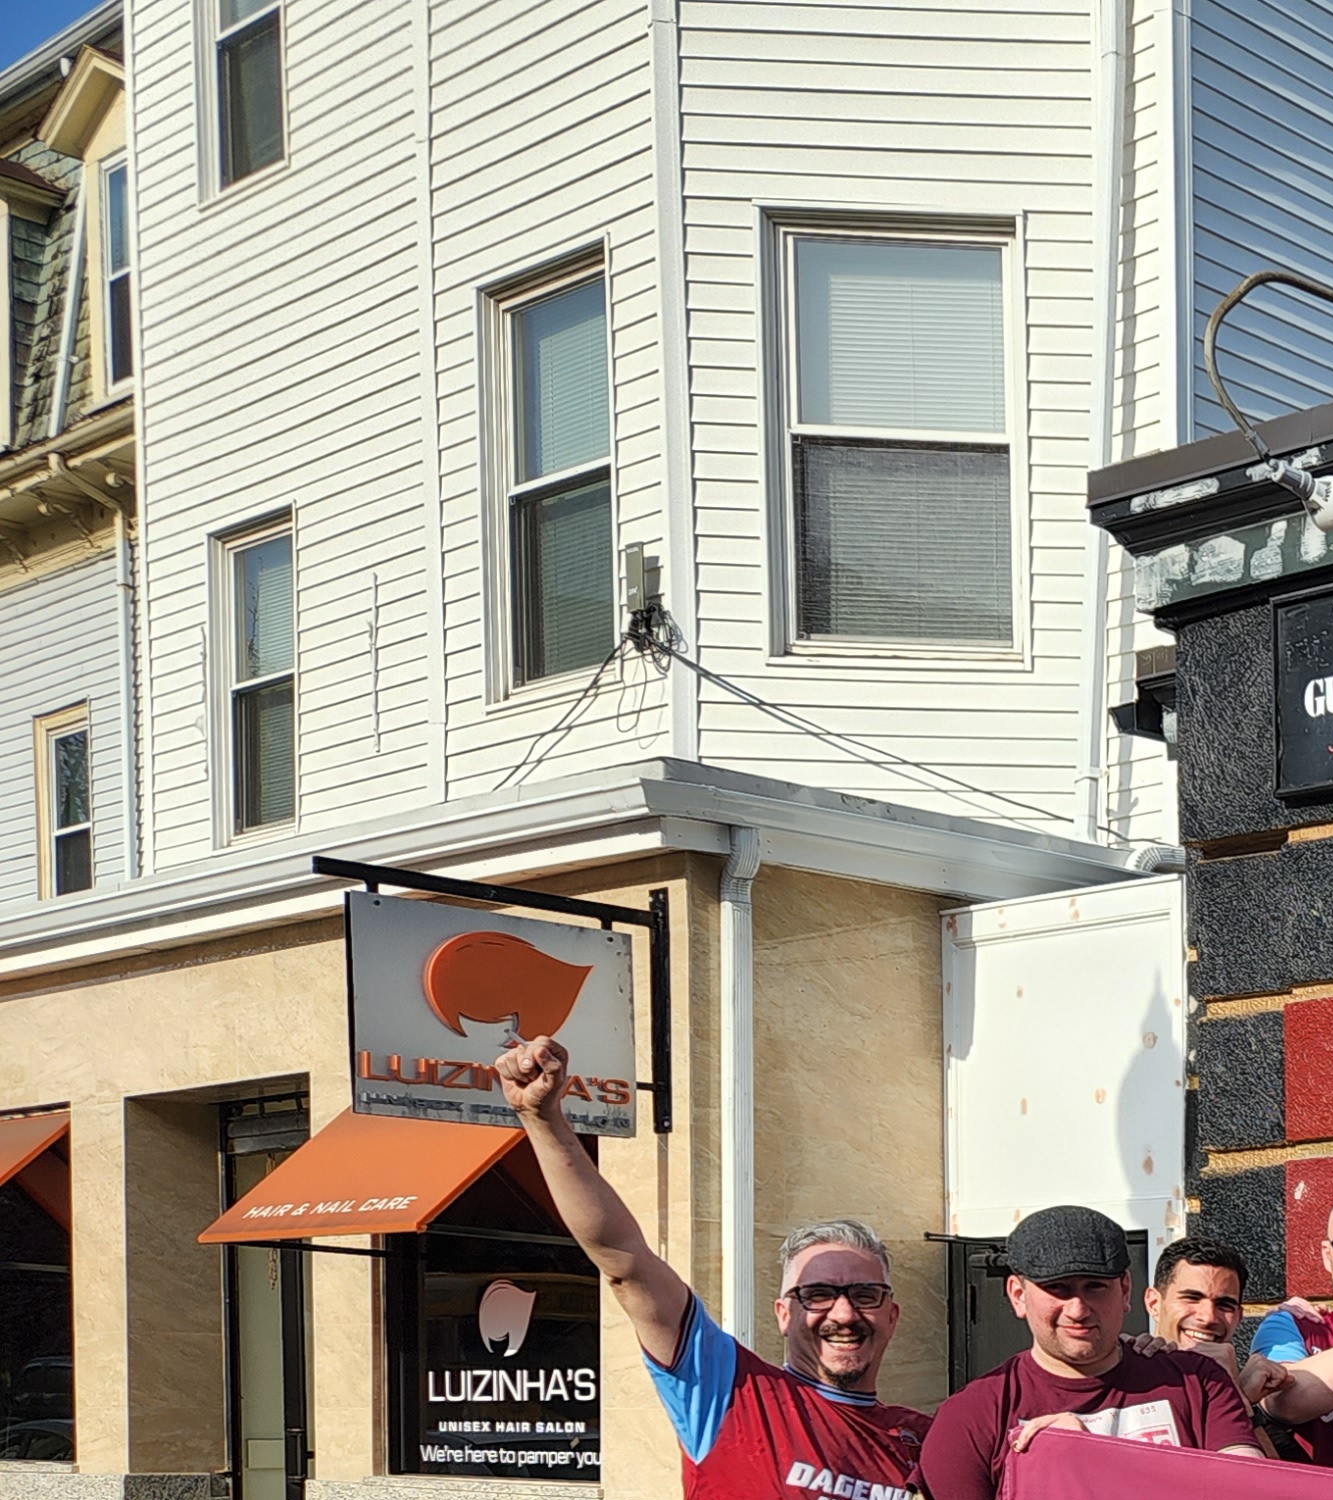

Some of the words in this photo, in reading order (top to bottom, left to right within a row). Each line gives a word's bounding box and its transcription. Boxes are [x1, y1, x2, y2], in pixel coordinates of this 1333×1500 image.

[357, 1050, 630, 1105] LUIZINA'S
[242, 1204, 293, 1219] HAIR
[291, 1203, 311, 1216] &
[309, 1200, 356, 1215] NAIL
[358, 1196, 418, 1211] CARE
[428, 1368, 596, 1402] LUIZINHA'S
[438, 1421, 491, 1432] UNISEX
[495, 1422, 530, 1432] HAIR
[535, 1422, 586, 1433] SALON
[420, 1445, 464, 1463] We're
[464, 1446, 498, 1463] here
[500, 1448, 516, 1464] to
[517, 1451, 574, 1467] pamper
